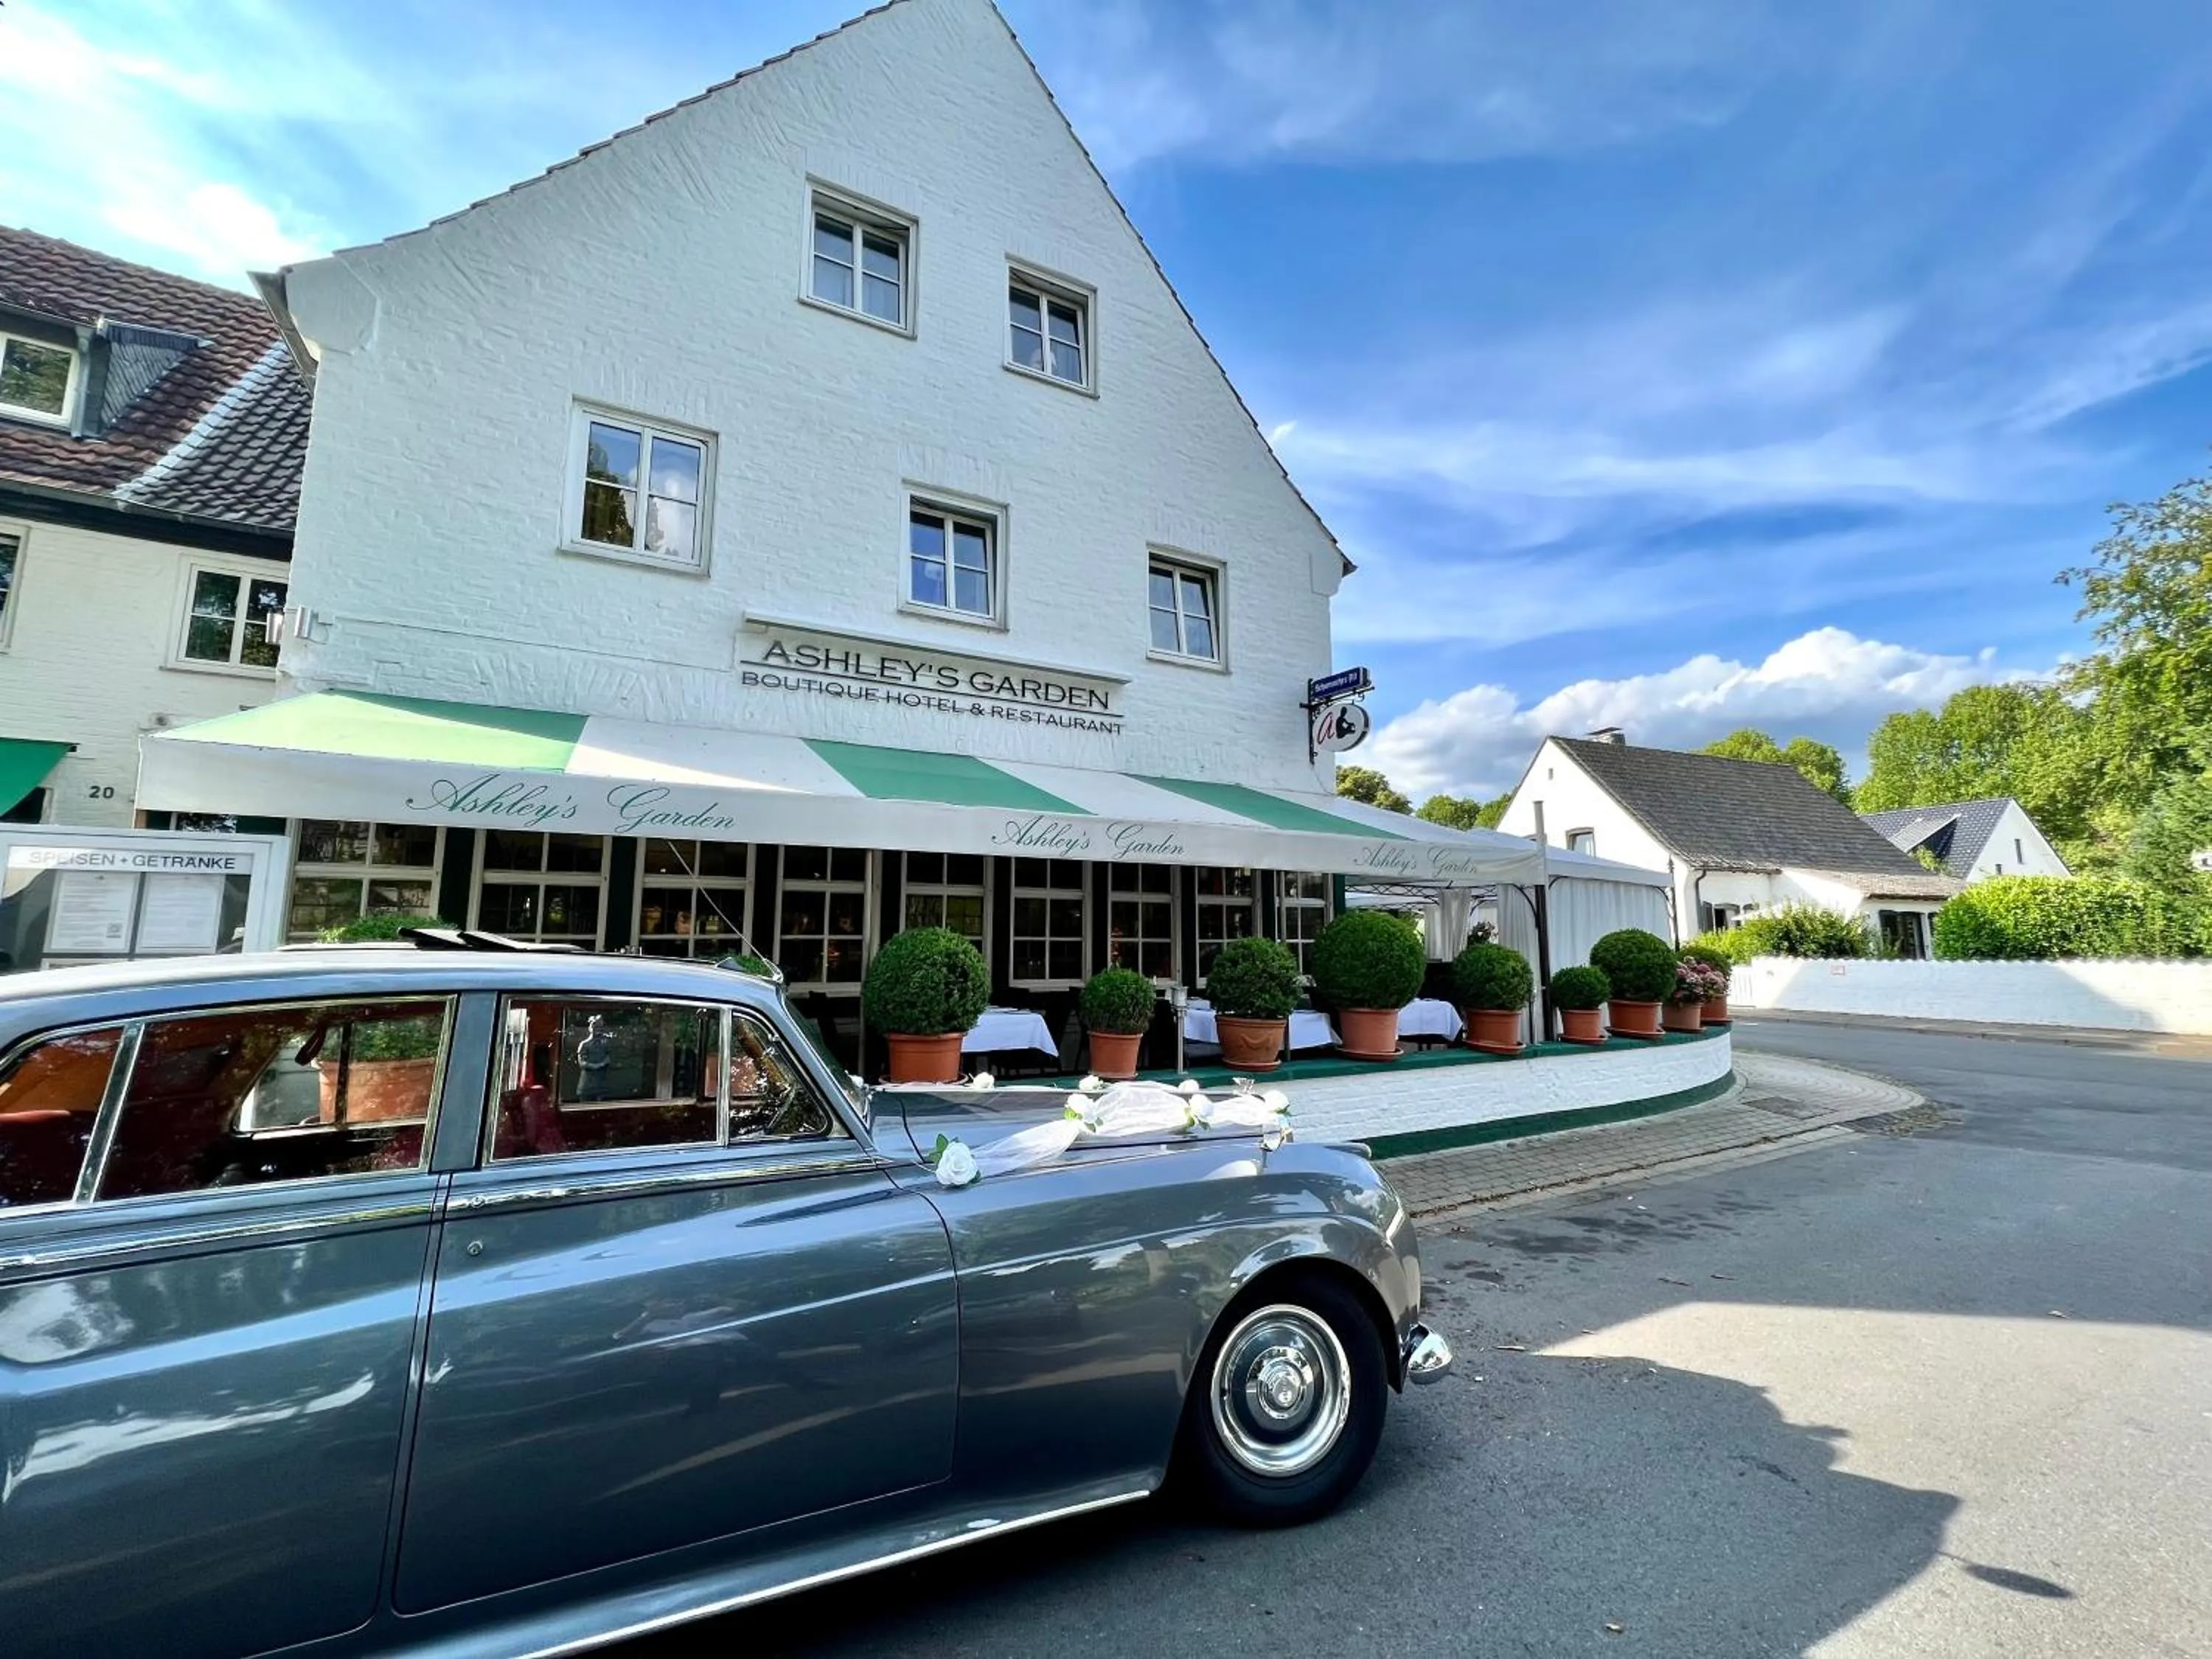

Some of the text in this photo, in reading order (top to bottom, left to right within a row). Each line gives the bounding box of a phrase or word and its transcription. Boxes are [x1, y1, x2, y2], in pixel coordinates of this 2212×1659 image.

[762, 639, 1108, 710] ASHLEY'S GARDEN
[741, 671, 1123, 736] BOUTIQUE HOTEL & RESTAURANT
[88, 785, 114, 799] 20
[406, 773, 736, 833] Ashley's Garden
[29, 851, 115, 865] SPEISEN
[132, 855, 236, 869] GETRÄNKE
[992, 815, 1184, 860] Ashley's Garden
[1354, 842, 1476, 878] Ashley's Garden
